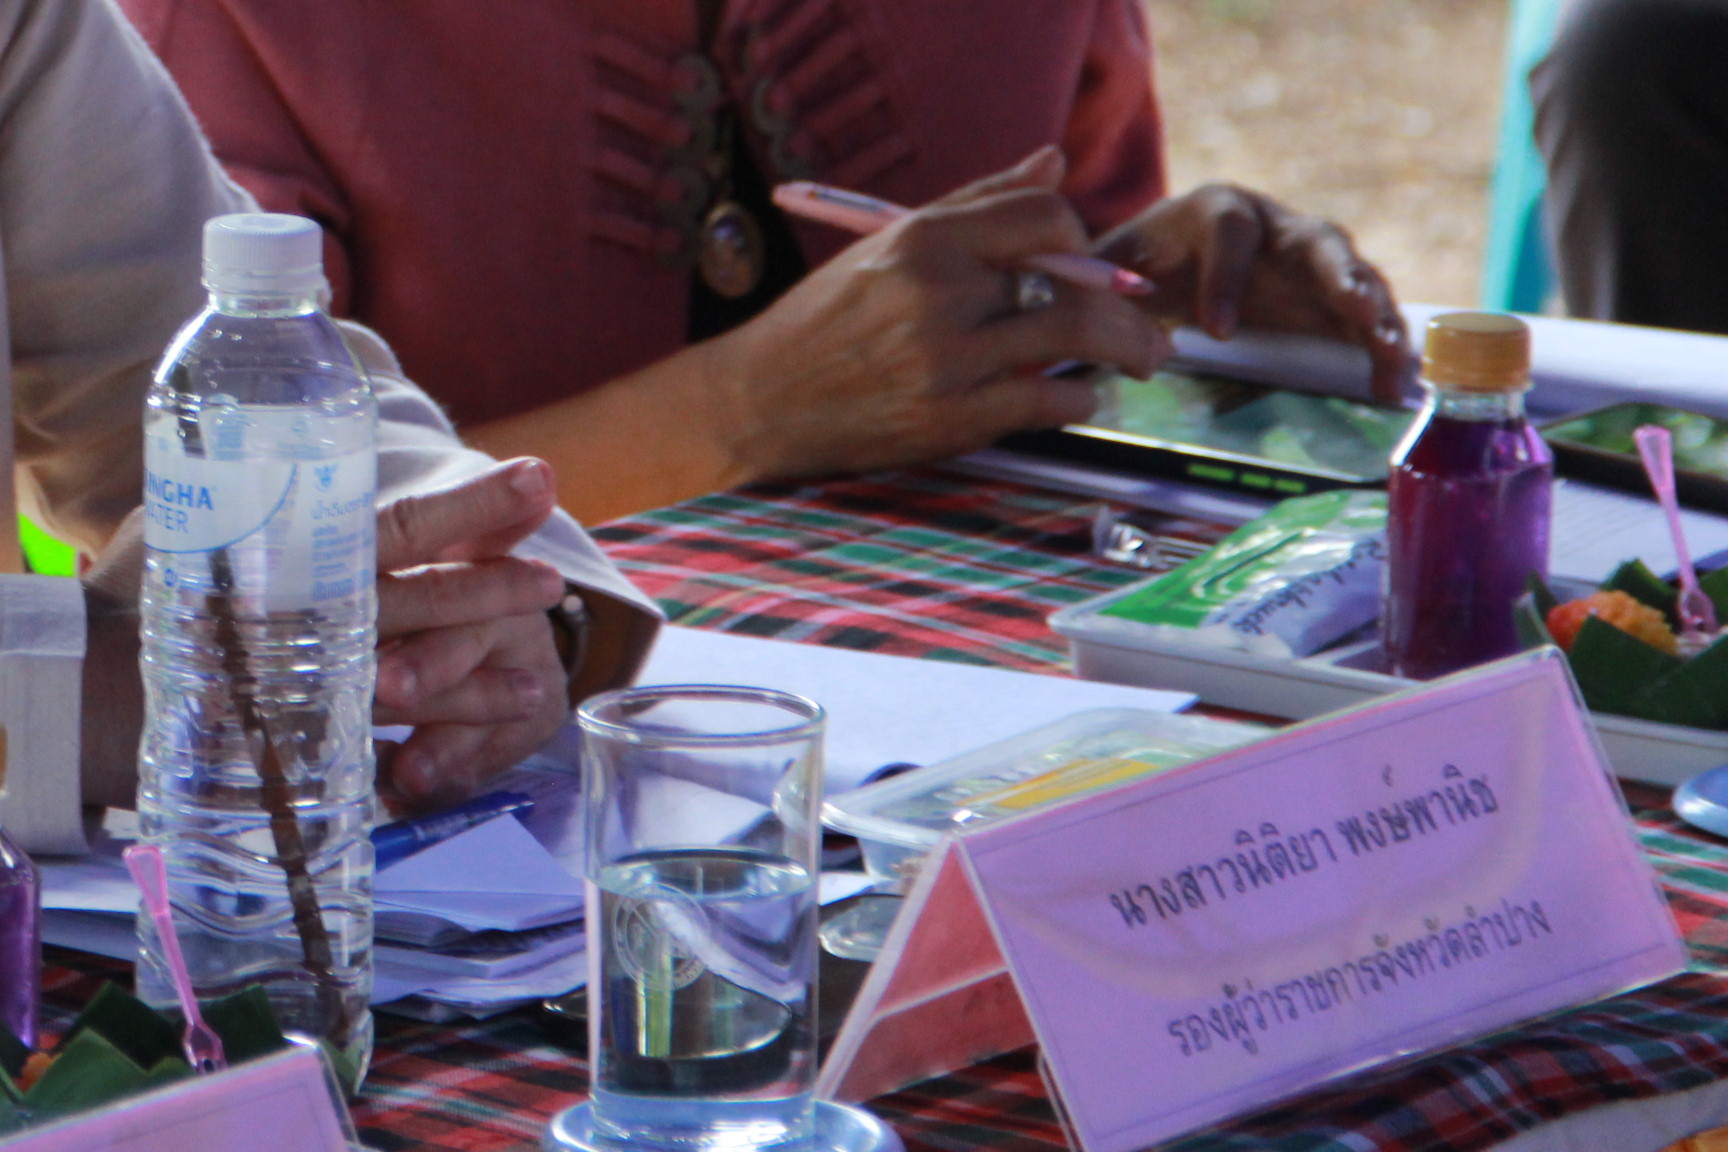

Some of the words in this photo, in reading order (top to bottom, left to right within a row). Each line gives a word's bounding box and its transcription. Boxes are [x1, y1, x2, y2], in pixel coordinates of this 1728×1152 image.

[144, 497, 190, 535] ATER
[146, 468, 215, 512] INGHA
[1335, 763, 1499, 857] พงษ์พานิช
[1168, 897, 1552, 1057] รองผู้ว่าราชการจังหวัดลำปาง
